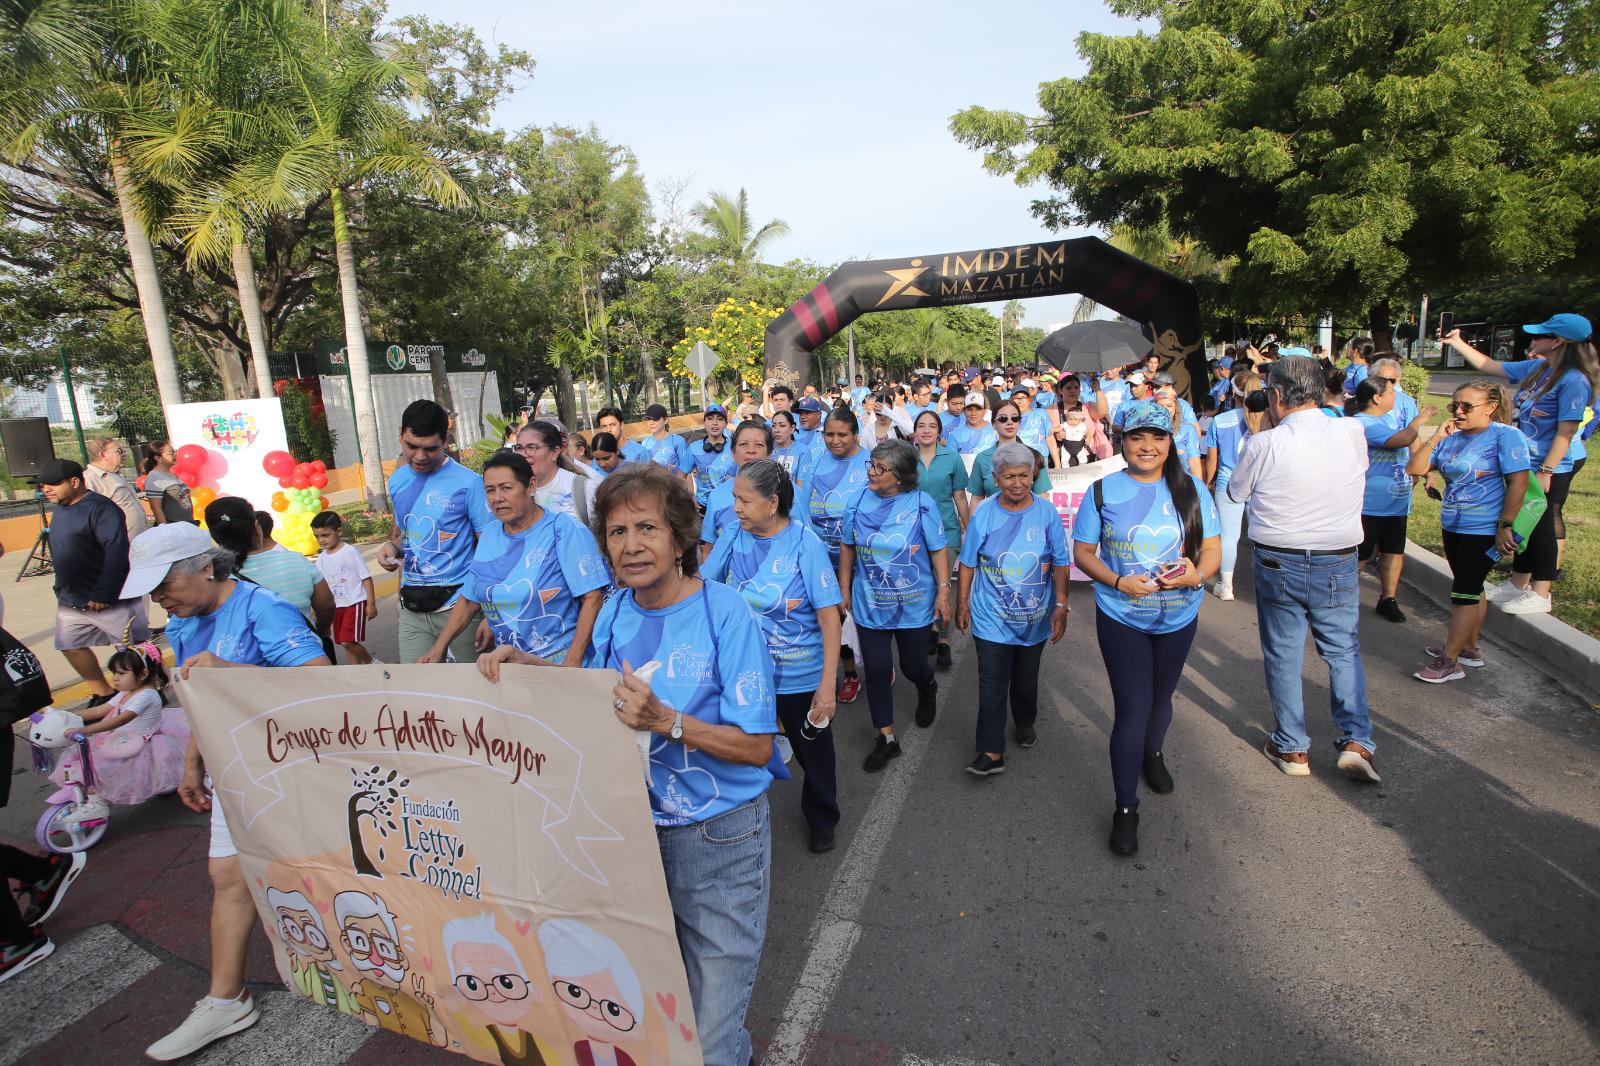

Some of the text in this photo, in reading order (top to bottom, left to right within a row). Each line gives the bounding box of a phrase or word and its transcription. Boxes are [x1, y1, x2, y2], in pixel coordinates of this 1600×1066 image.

[942, 243, 1065, 276] IMDEM
[941, 266, 1064, 296] MAZATLÁN
[684, 670, 713, 681] Coppe
[266, 718, 332, 764] Grupo
[338, 711, 367, 749] de
[462, 716, 546, 785] Mayor
[402, 796, 460, 822] Fundación
[402, 816, 460, 866] Letty
[408, 853, 482, 901] Coppel
